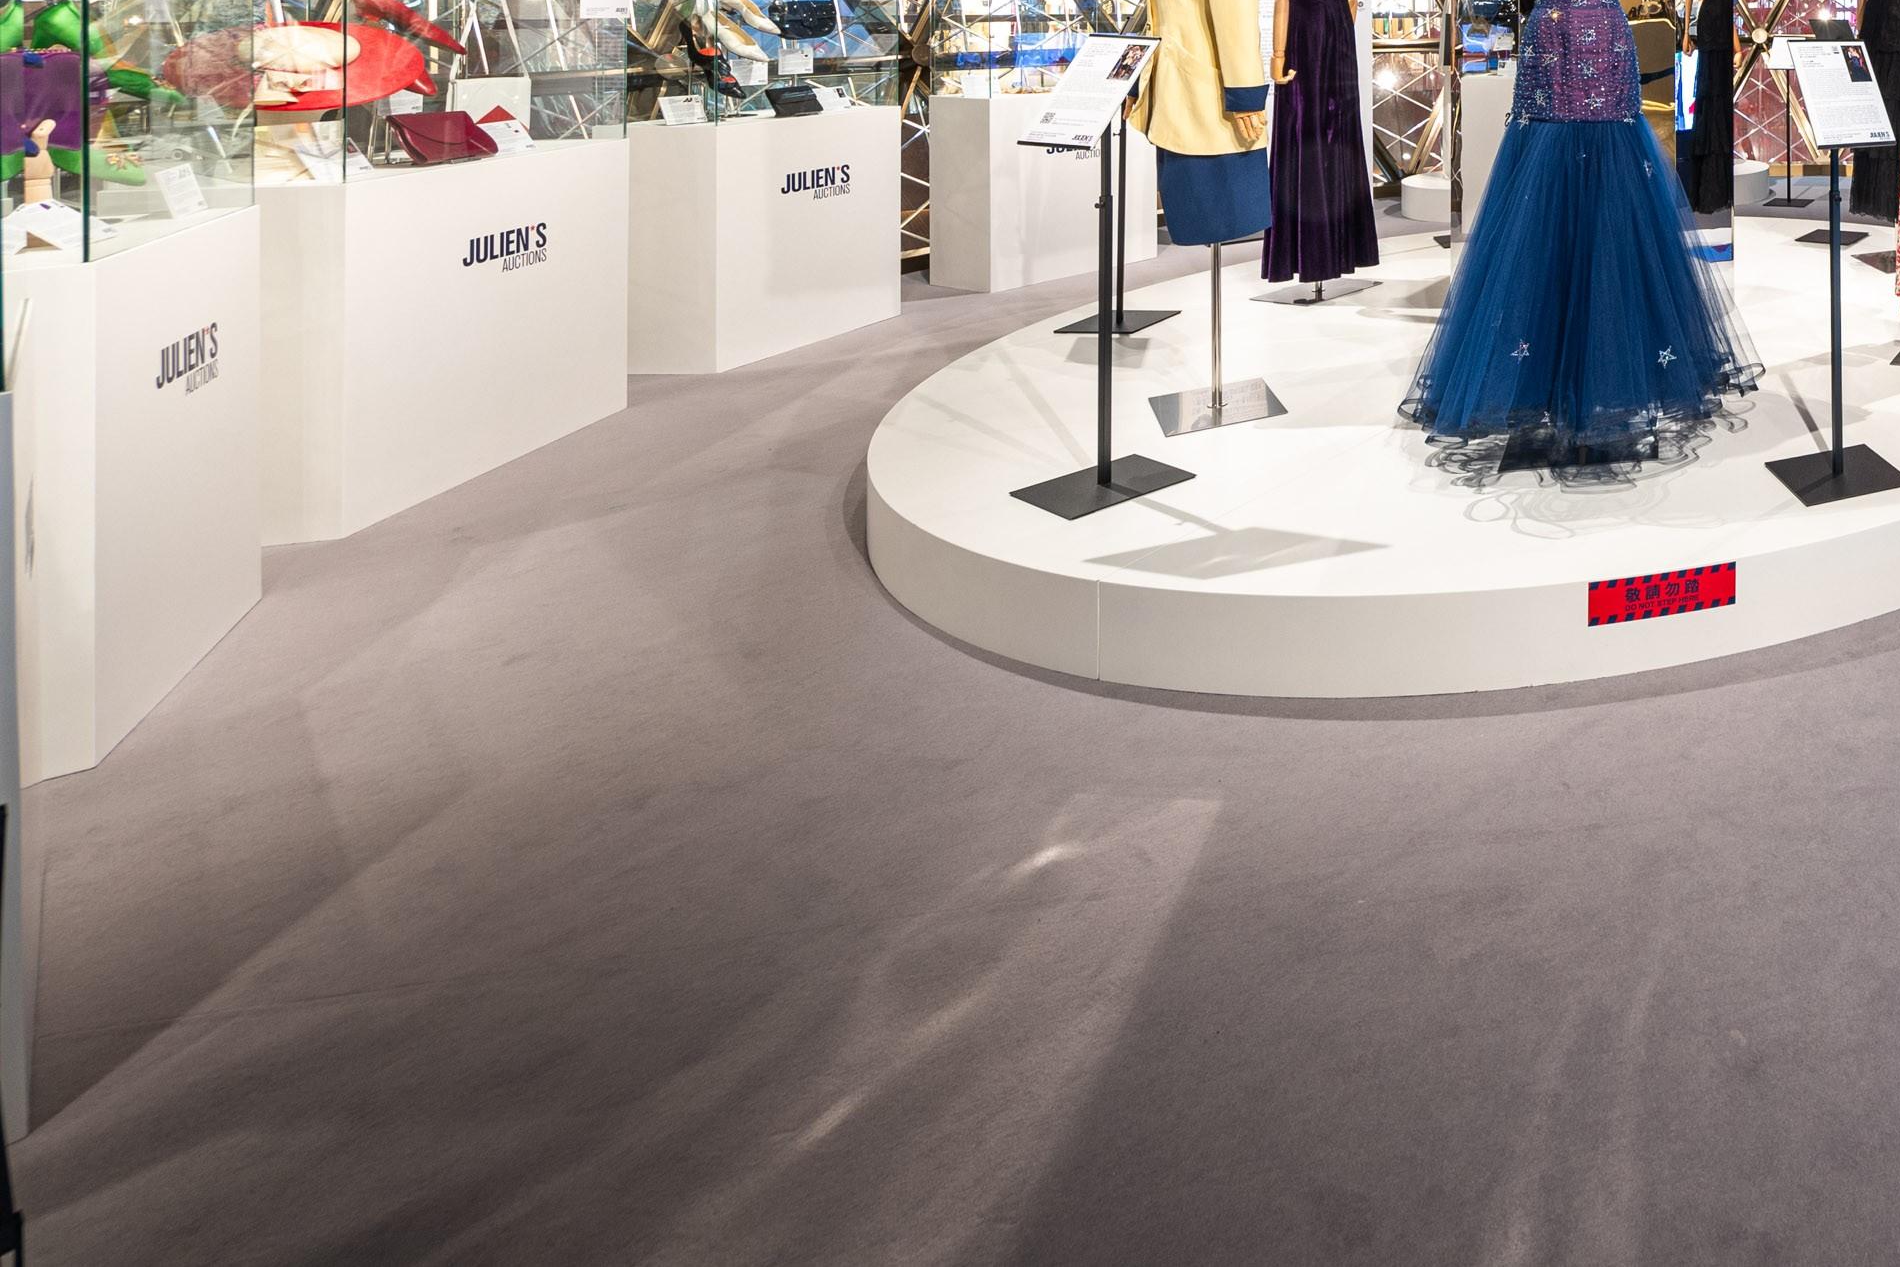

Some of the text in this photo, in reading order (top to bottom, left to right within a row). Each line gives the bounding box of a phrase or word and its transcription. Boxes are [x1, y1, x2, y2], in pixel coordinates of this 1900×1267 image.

[1075, 149, 1101, 160] AUCTIO
[813, 183, 851, 201] AUCTIONS
[502, 248, 547, 272] AUCTIONS
[1625, 579, 1699, 603] 敬請勿踏
[1625, 595, 1698, 612] DO NOT STEP HERE
